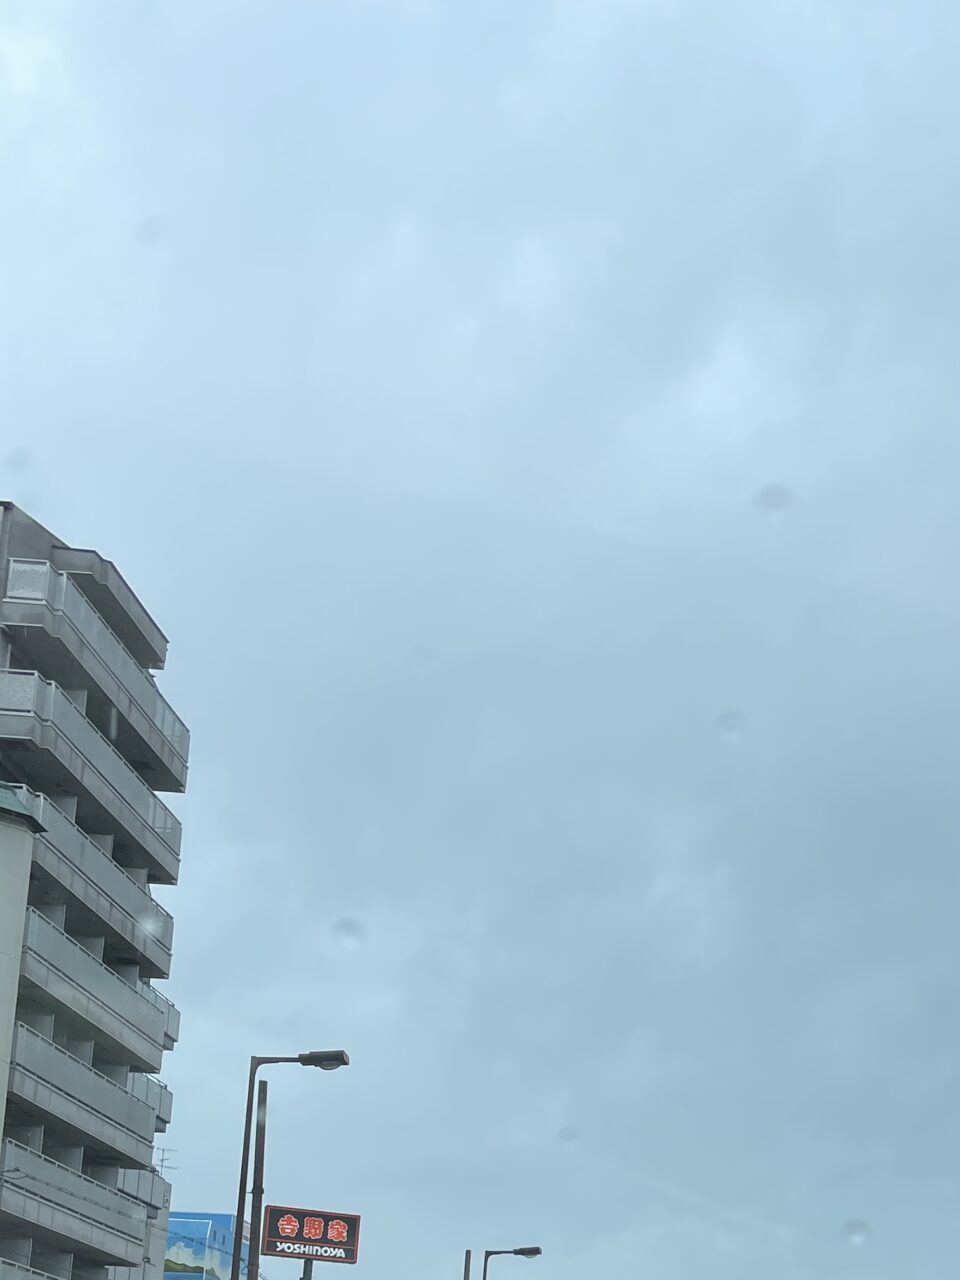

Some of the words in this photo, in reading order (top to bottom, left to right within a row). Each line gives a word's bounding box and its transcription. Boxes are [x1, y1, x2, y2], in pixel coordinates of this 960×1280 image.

[278, 1214, 349, 1241] 吉野家
[276, 1242, 346, 1258] YOSHINOYA
